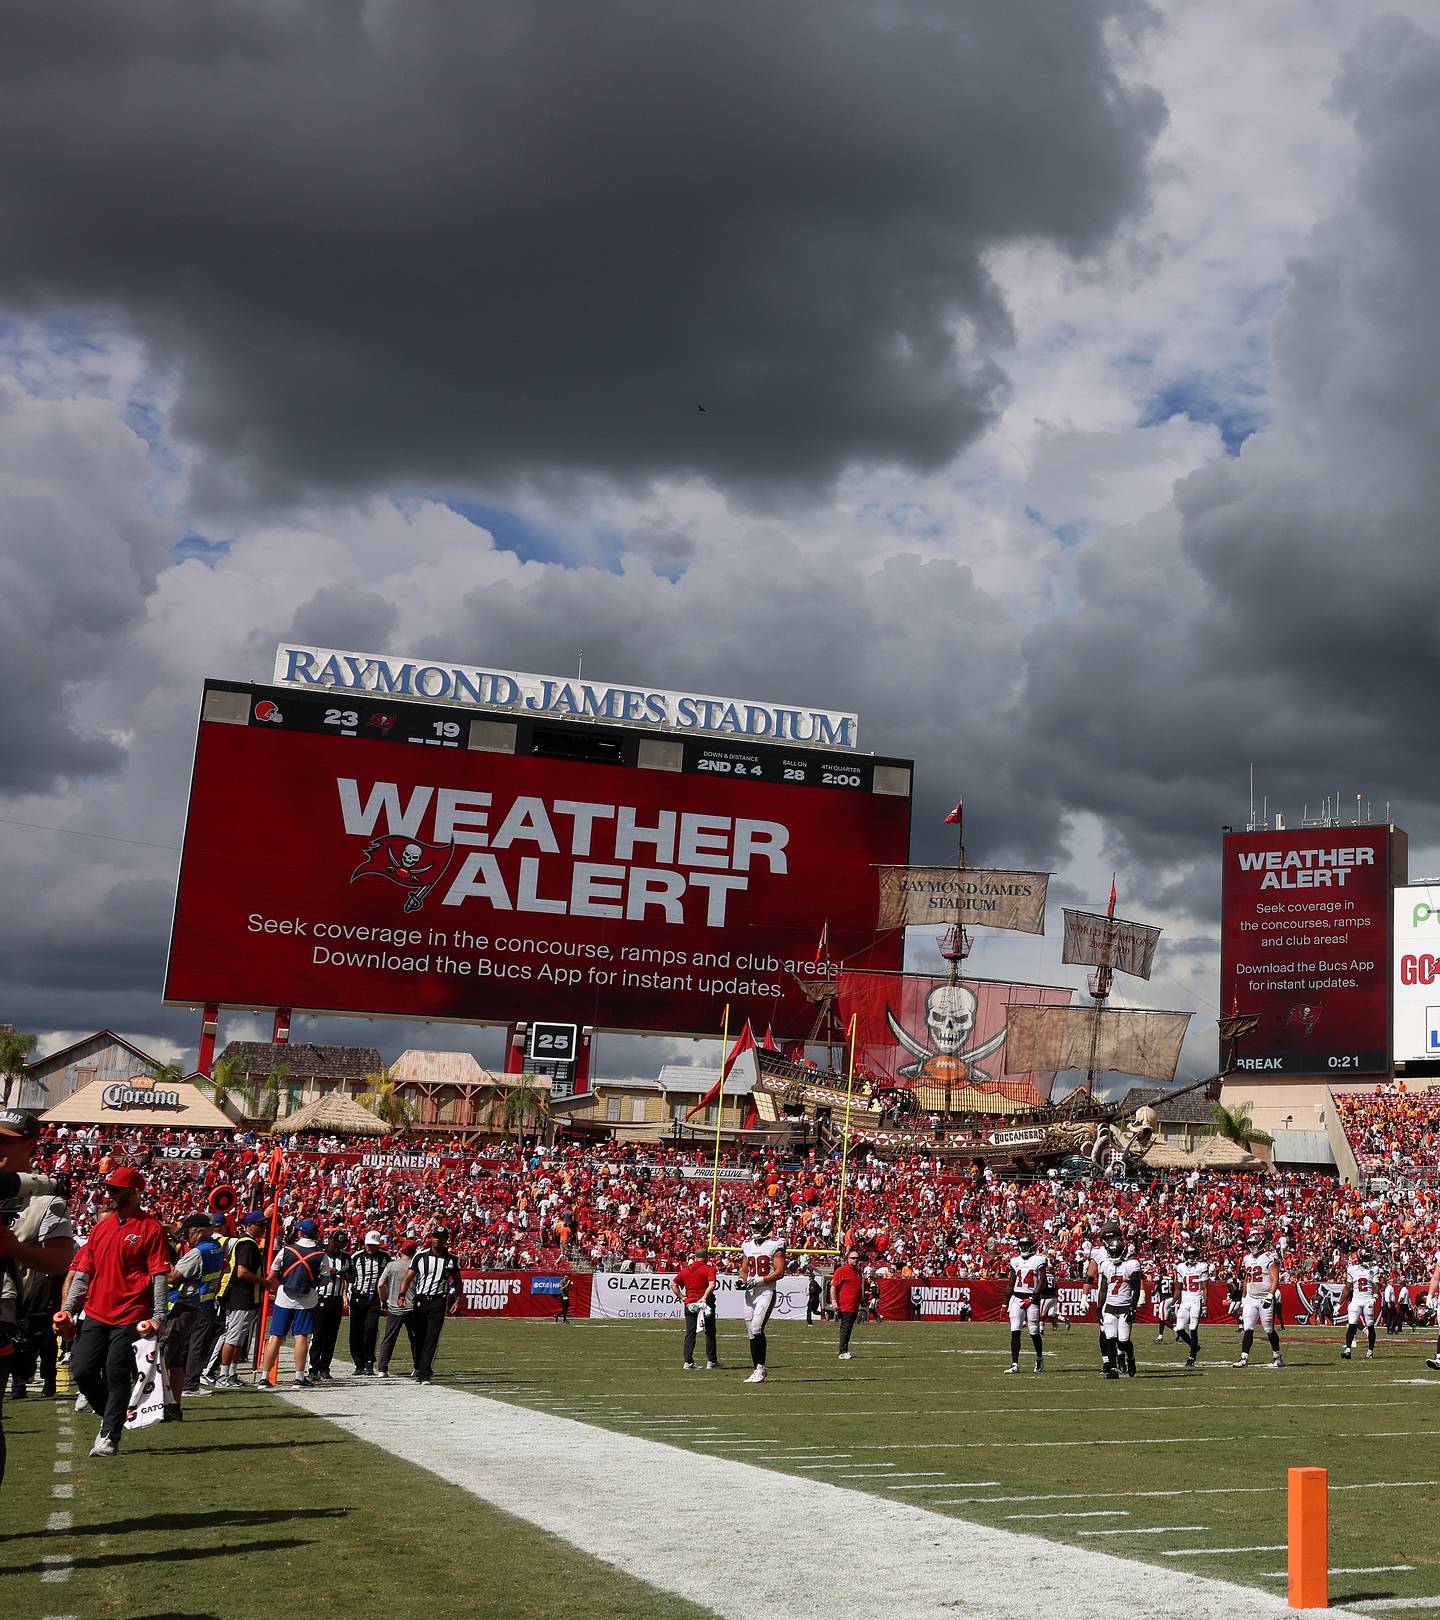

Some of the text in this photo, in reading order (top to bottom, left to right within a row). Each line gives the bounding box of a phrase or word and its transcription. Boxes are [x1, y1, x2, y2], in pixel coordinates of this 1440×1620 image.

[282, 649, 854, 747] RAYMOND JAMES STADIUM
[323, 708, 359, 727] 23
[433, 721, 460, 738] 19
[703, 750, 723, 759] DOWN
[729, 753, 759, 763] DISTANCE
[782, 759, 798, 768] BALL
[697, 759, 763, 776] 2ND & 4
[783, 768, 805, 781] 28
[821, 764, 862, 774] 4TH QUARTER
[822, 772, 861, 788] 2:00
[336, 777, 791, 875] WEATHER
[1238, 847, 1375, 871] WEATHER
[1260, 868, 1352, 890] ALERT
[441, 851, 749, 928] ALERT
[898, 880, 1032, 897] RAYMOND JAMES
[929, 897, 997, 911] STADIUM
[1256, 900, 1355, 914] Seek coverage in
[1069, 922, 1102, 938] WORLD
[1240, 916, 1371, 931] the concourses, ramps
[247, 913, 844, 977] Seek coverage in the concourse, ramps and club areas!
[1261, 932, 1349, 947] and club areas!
[312, 946, 786, 998] Download the Bucs App for instant updates.
[1236, 959, 1375, 975] Download the Bucs App
[1400, 953, 1436, 985] GO
[1248, 977, 1359, 992] for instant updates.
[539, 1034, 568, 1050] 25
[1237, 1058, 1283, 1069] BREAK
[1328, 1056, 1360, 1068] 0:21
[102, 1083, 181, 1108] Corona
[994, 1128, 1046, 1144] BUCCANEERS
[161, 1147, 203, 1159] 1976
[362, 1153, 441, 1169] BUCCANEERS
[461, 1278, 522, 1295] RISTAN'S
[607, 1277, 672, 1291] GLAZER
[1016, 1269, 1036, 1288] 14
[1110, 1275, 1124, 1295] 7
[1357, 1278, 1368, 1292] 2
[466, 1294, 509, 1310] TROOP
[630, 1293, 683, 1304] FOUNDA
[618, 1308, 682, 1319] Glasses For All
